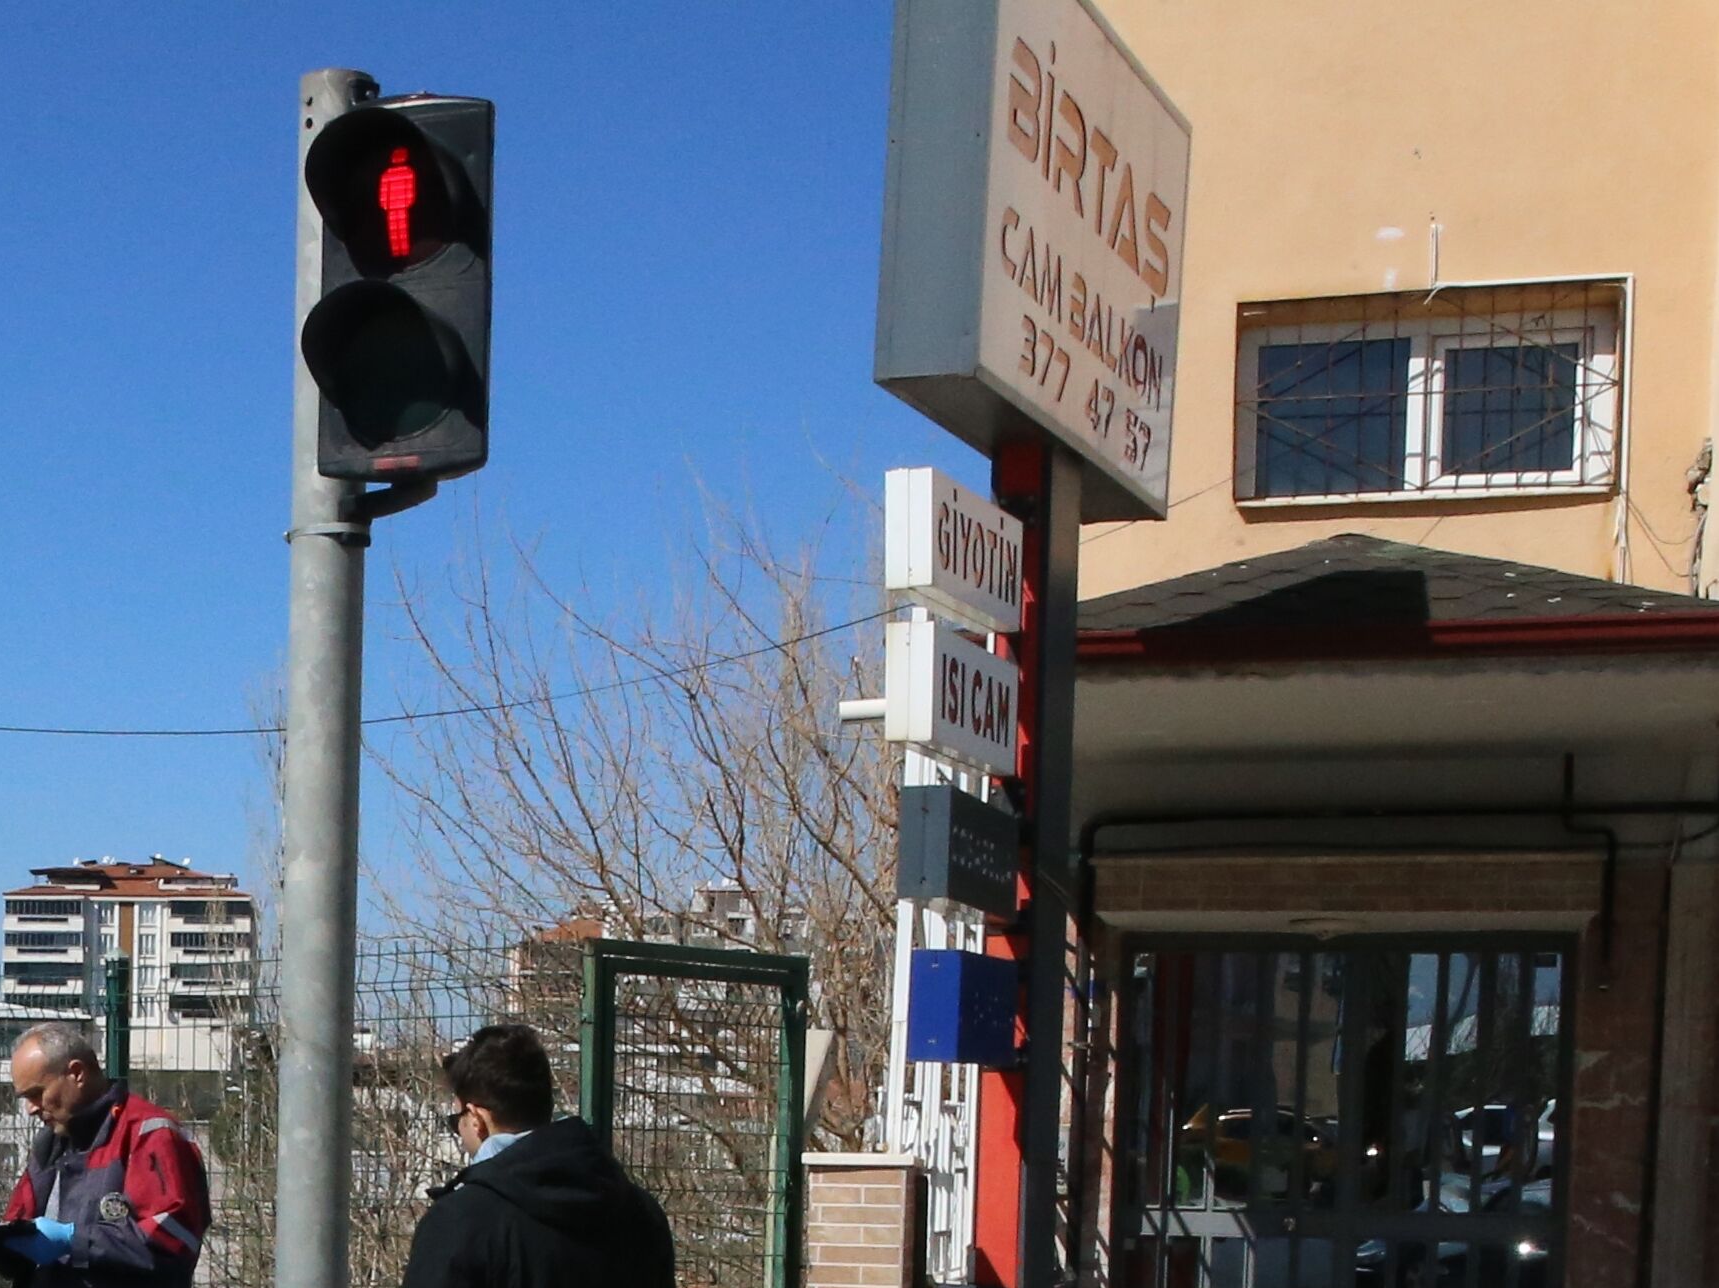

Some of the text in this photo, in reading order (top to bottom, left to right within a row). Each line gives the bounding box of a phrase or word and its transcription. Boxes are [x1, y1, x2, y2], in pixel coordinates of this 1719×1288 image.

[1000, 206, 1164, 412] CAM BALKON
[1018, 314, 1071, 402] 377
[1085, 378, 1115, 439] 47
[937, 488, 1017, 606] GİYOTİN
[971, 669, 1010, 748] CAM
